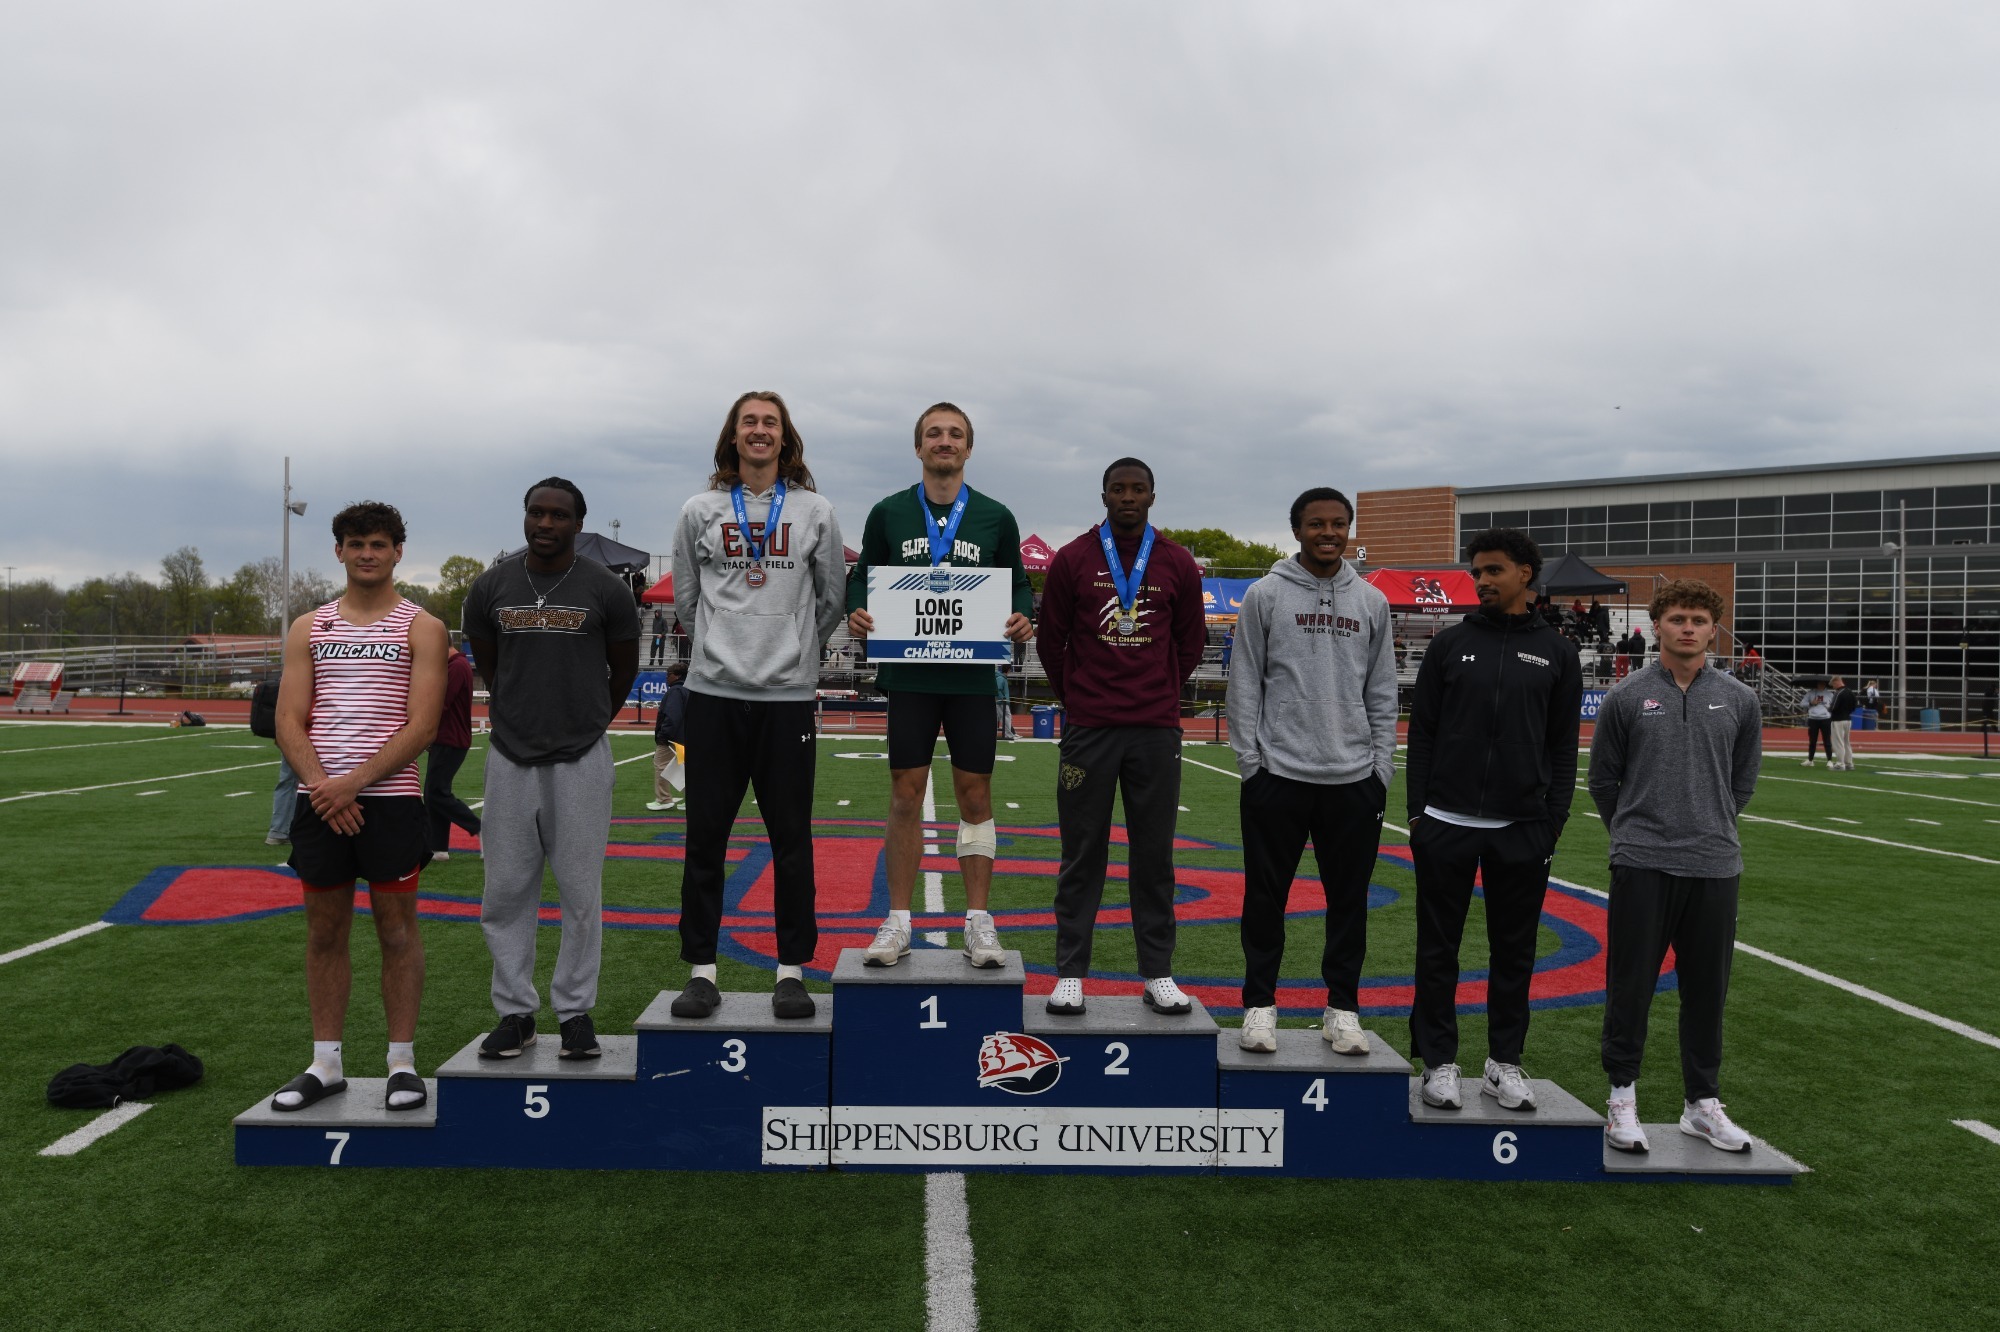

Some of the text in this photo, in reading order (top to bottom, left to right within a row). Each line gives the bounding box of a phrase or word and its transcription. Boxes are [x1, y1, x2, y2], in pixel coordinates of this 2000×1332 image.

[720, 522, 792, 557] ESU
[902, 538, 980, 563] SLIPP ROCK
[905, 554, 979, 566] UNIVRSITY
[1357, 549, 1366, 558] G
[722, 561, 752, 570] TRACK
[765, 560, 795, 569] FIELD
[915, 599, 963, 616] LONG
[914, 618, 963, 636] JUMP
[1295, 614, 1360, 633] WARRORS
[314, 643, 402, 661] VULCANS
[904, 648, 974, 659] CHAMPION
[642, 682, 668, 694] CHA
[1580, 705, 1598, 716] CO
[919, 995, 947, 1029] 1
[720, 1038, 747, 1073] 3
[1104, 1042, 1130, 1075] 2
[523, 1085, 551, 1119] 5
[1301, 1079, 1329, 1112] 4
[766, 1118, 1279, 1153] SHIPPENSBURG UNIVERSITY
[325, 1131, 350, 1165] 7
[1492, 1131, 1518, 1165] 6
